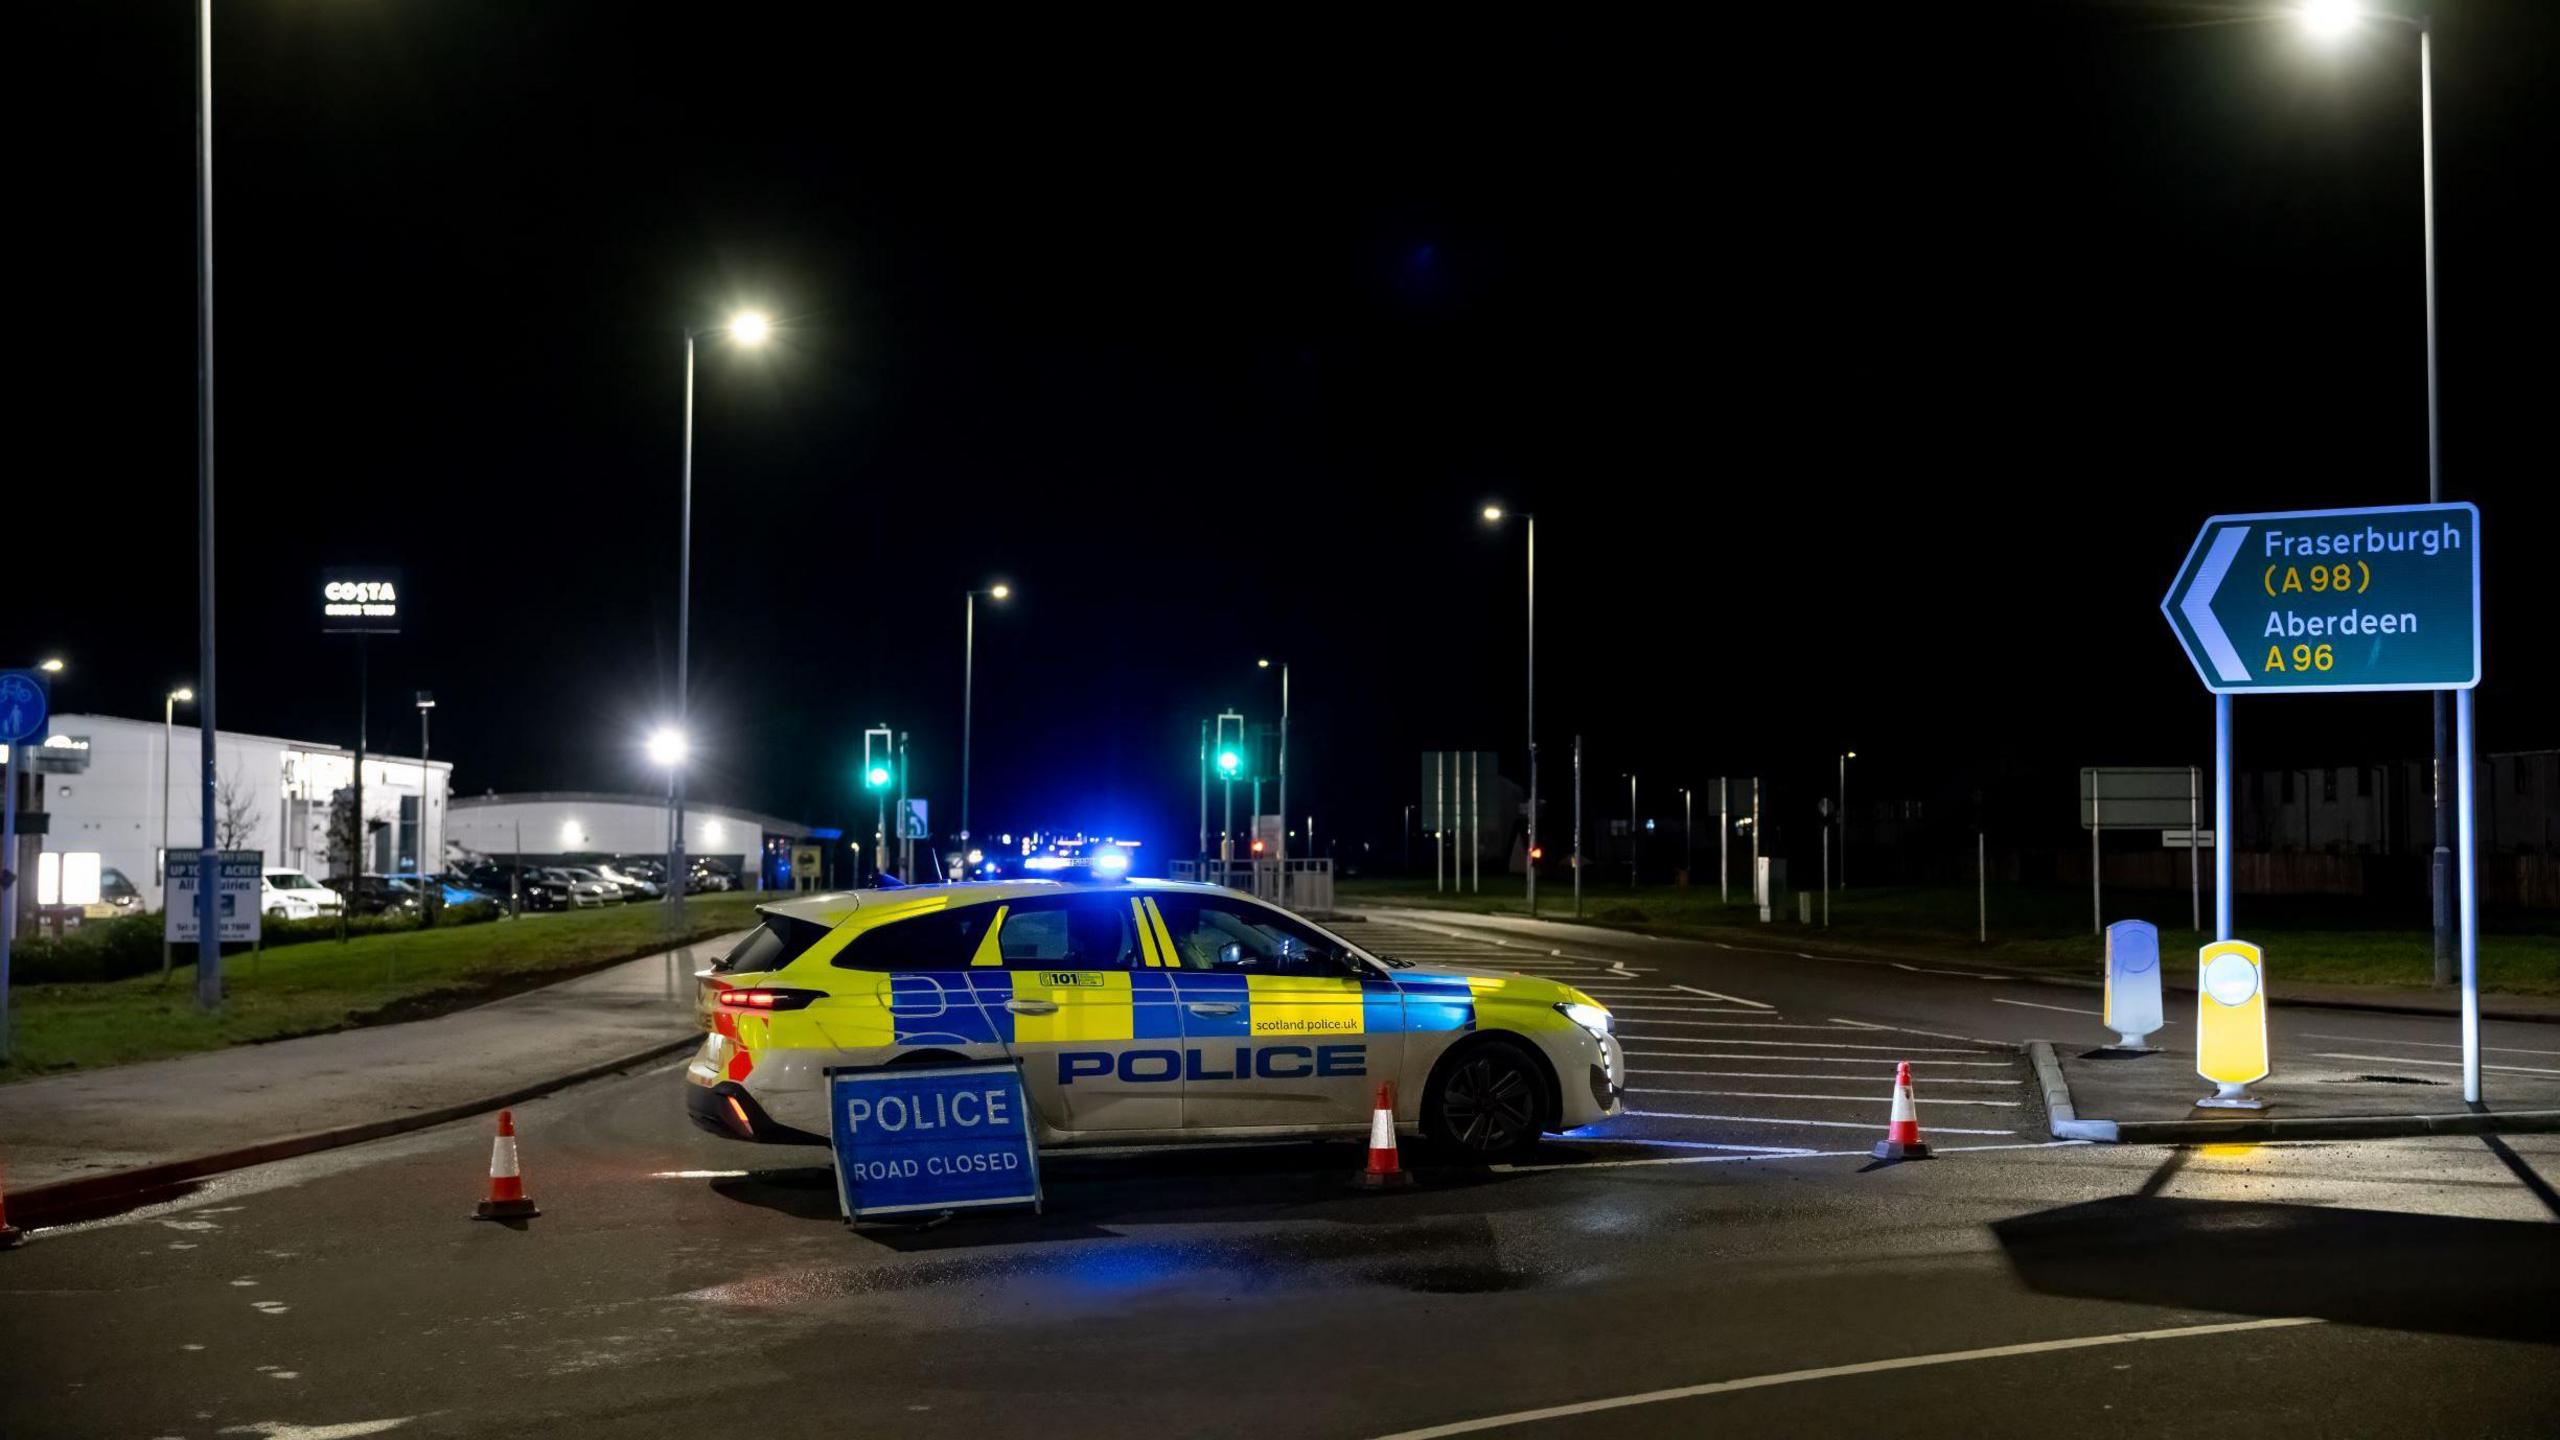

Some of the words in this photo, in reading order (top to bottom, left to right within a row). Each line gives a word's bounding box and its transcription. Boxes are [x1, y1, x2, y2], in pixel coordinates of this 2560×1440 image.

[2265, 522, 2461, 557] Fraserburgh
[325, 581, 396, 603] COSTA
[2264, 609, 2417, 637] Aberdeen
[224, 864, 259, 876] ACRES
[179, 880, 194, 891] All
[1052, 973, 1078, 985] 101
[1256, 1018, 1358, 1031] scotland.police.uk
[1058, 1044, 1367, 1085] POLICE
[848, 1089, 1010, 1134] POLICE
[854, 1159, 919, 1181] ROAD
[927, 1152, 1018, 1175] CLOSED
